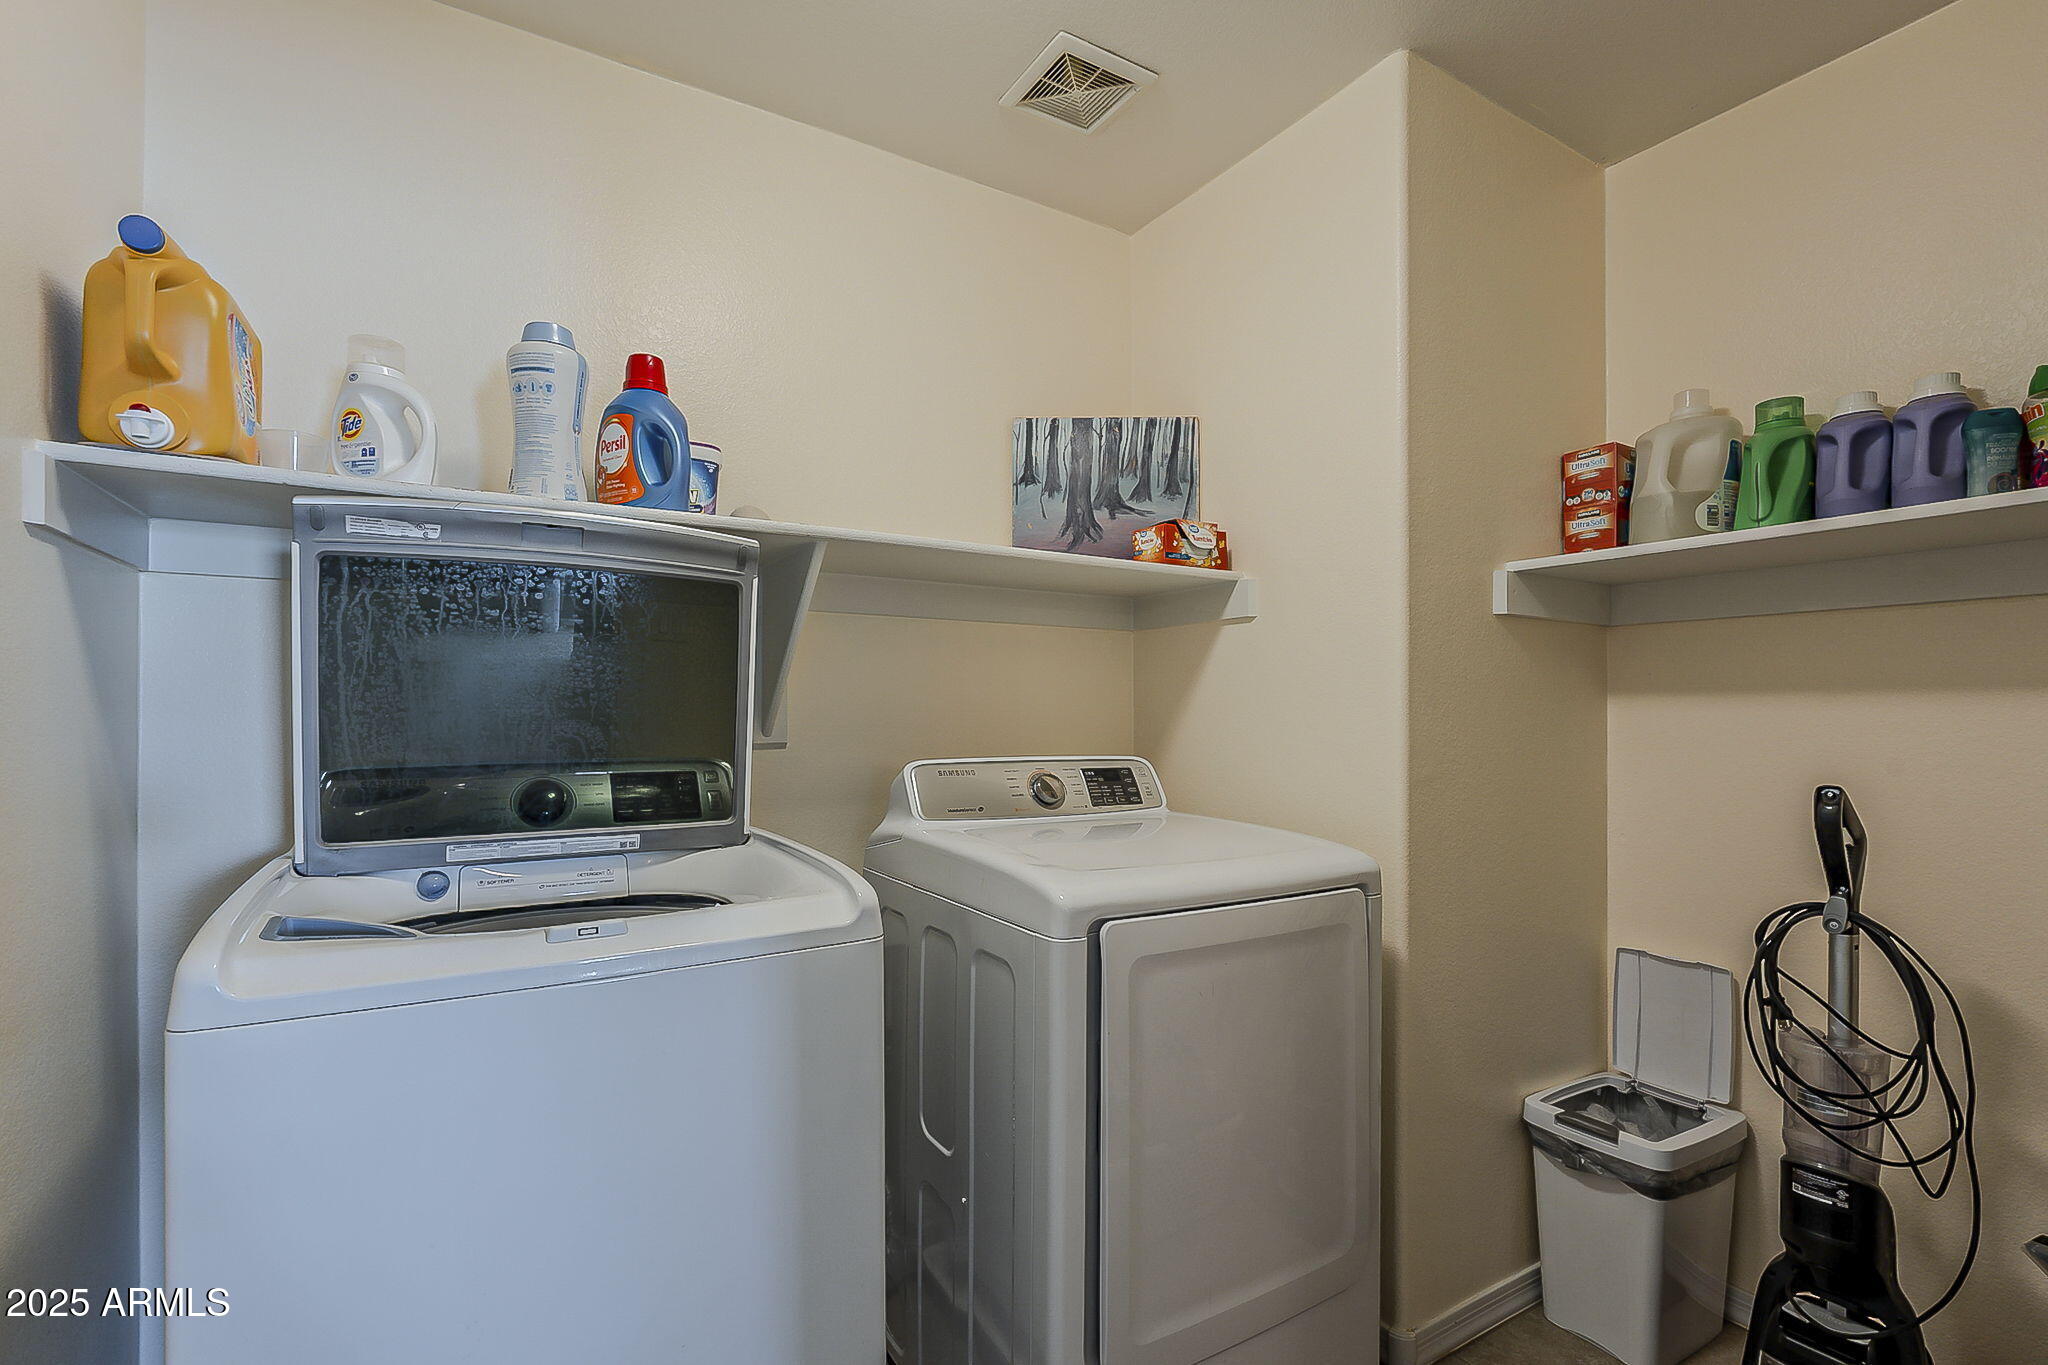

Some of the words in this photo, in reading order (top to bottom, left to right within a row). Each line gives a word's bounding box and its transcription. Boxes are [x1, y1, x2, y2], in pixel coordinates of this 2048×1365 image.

[341, 416, 362, 437] Tide
[601, 434, 626, 457] Persil
[1571, 458, 1606, 471] UltraSoft
[1571, 518, 1606, 530] UltraSoft
[937, 769, 976, 777] SAMSUNG
[577, 870, 606, 878] DETERGENT
[487, 878, 515, 886] SOFTENER
